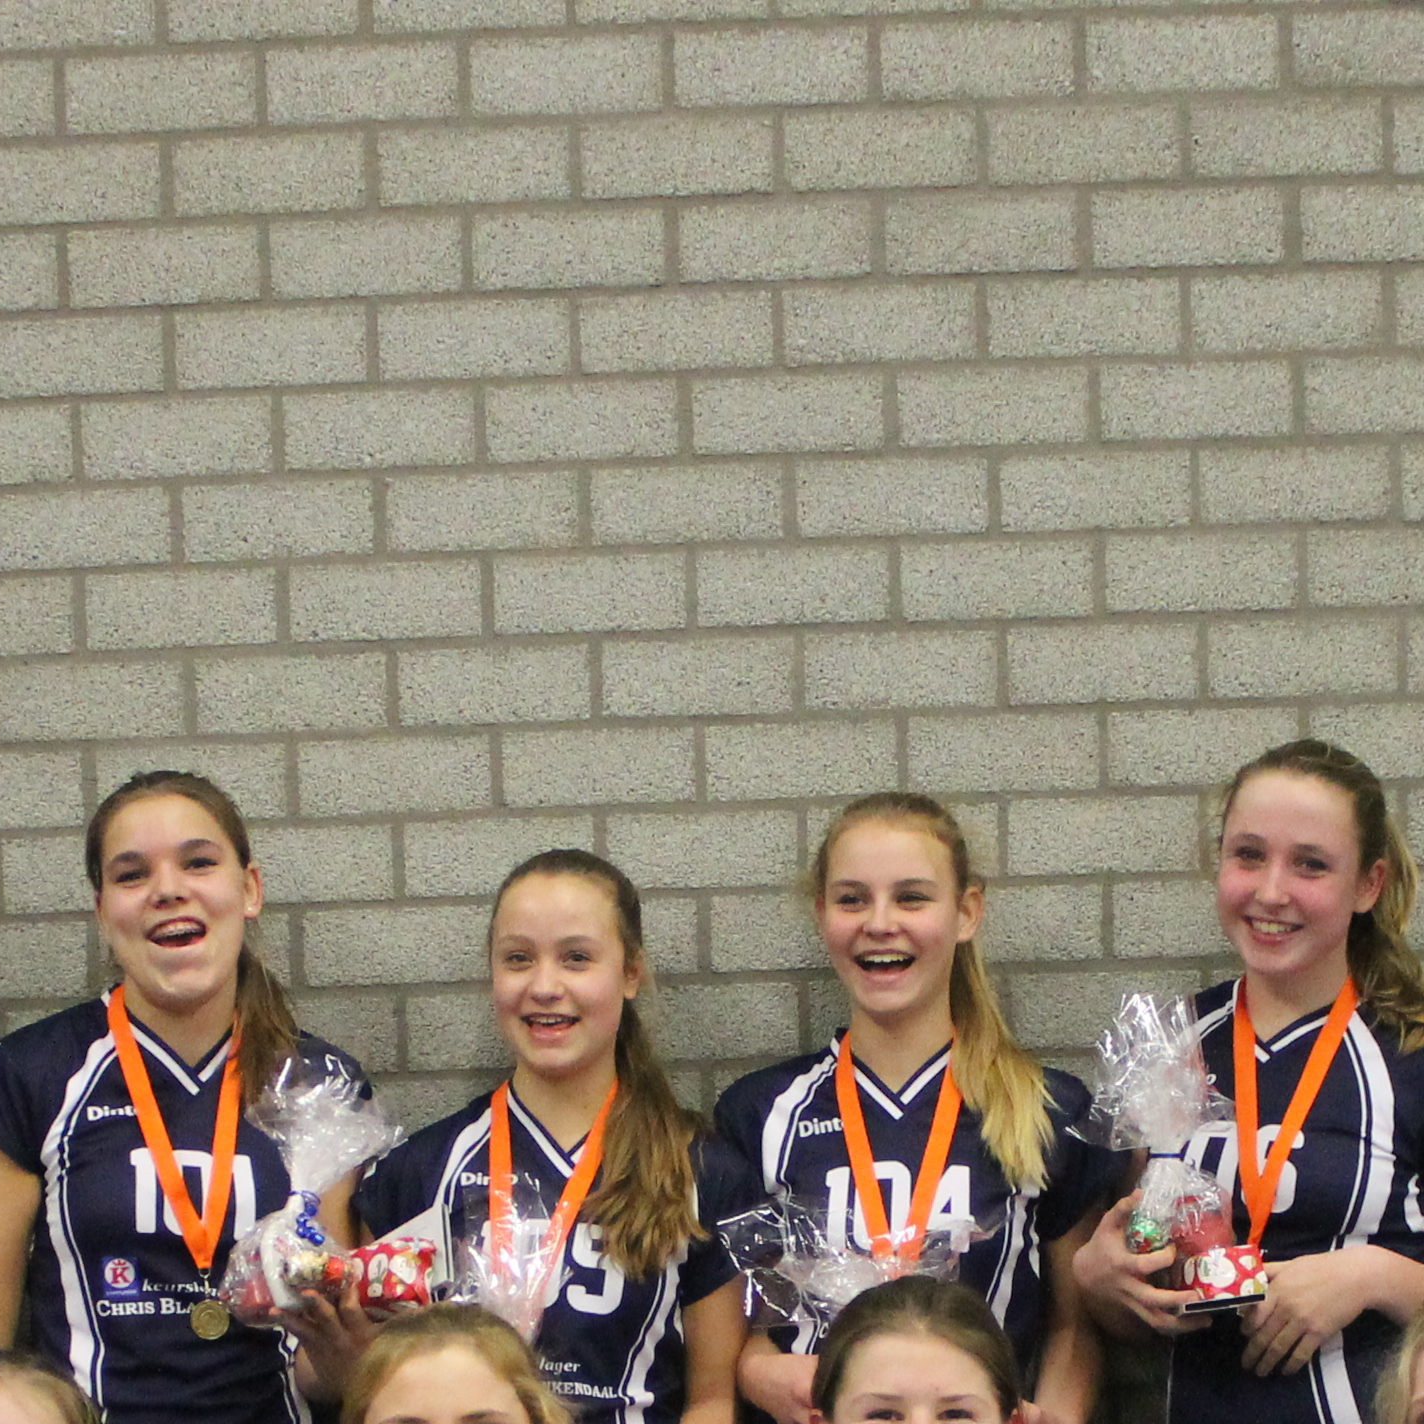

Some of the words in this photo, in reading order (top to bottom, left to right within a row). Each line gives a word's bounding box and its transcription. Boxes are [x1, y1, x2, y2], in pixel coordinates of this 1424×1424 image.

[87, 1104, 136, 1121] Dint
[798, 1117, 844, 1138] Dint
[825, 1160, 976, 1253] 104
